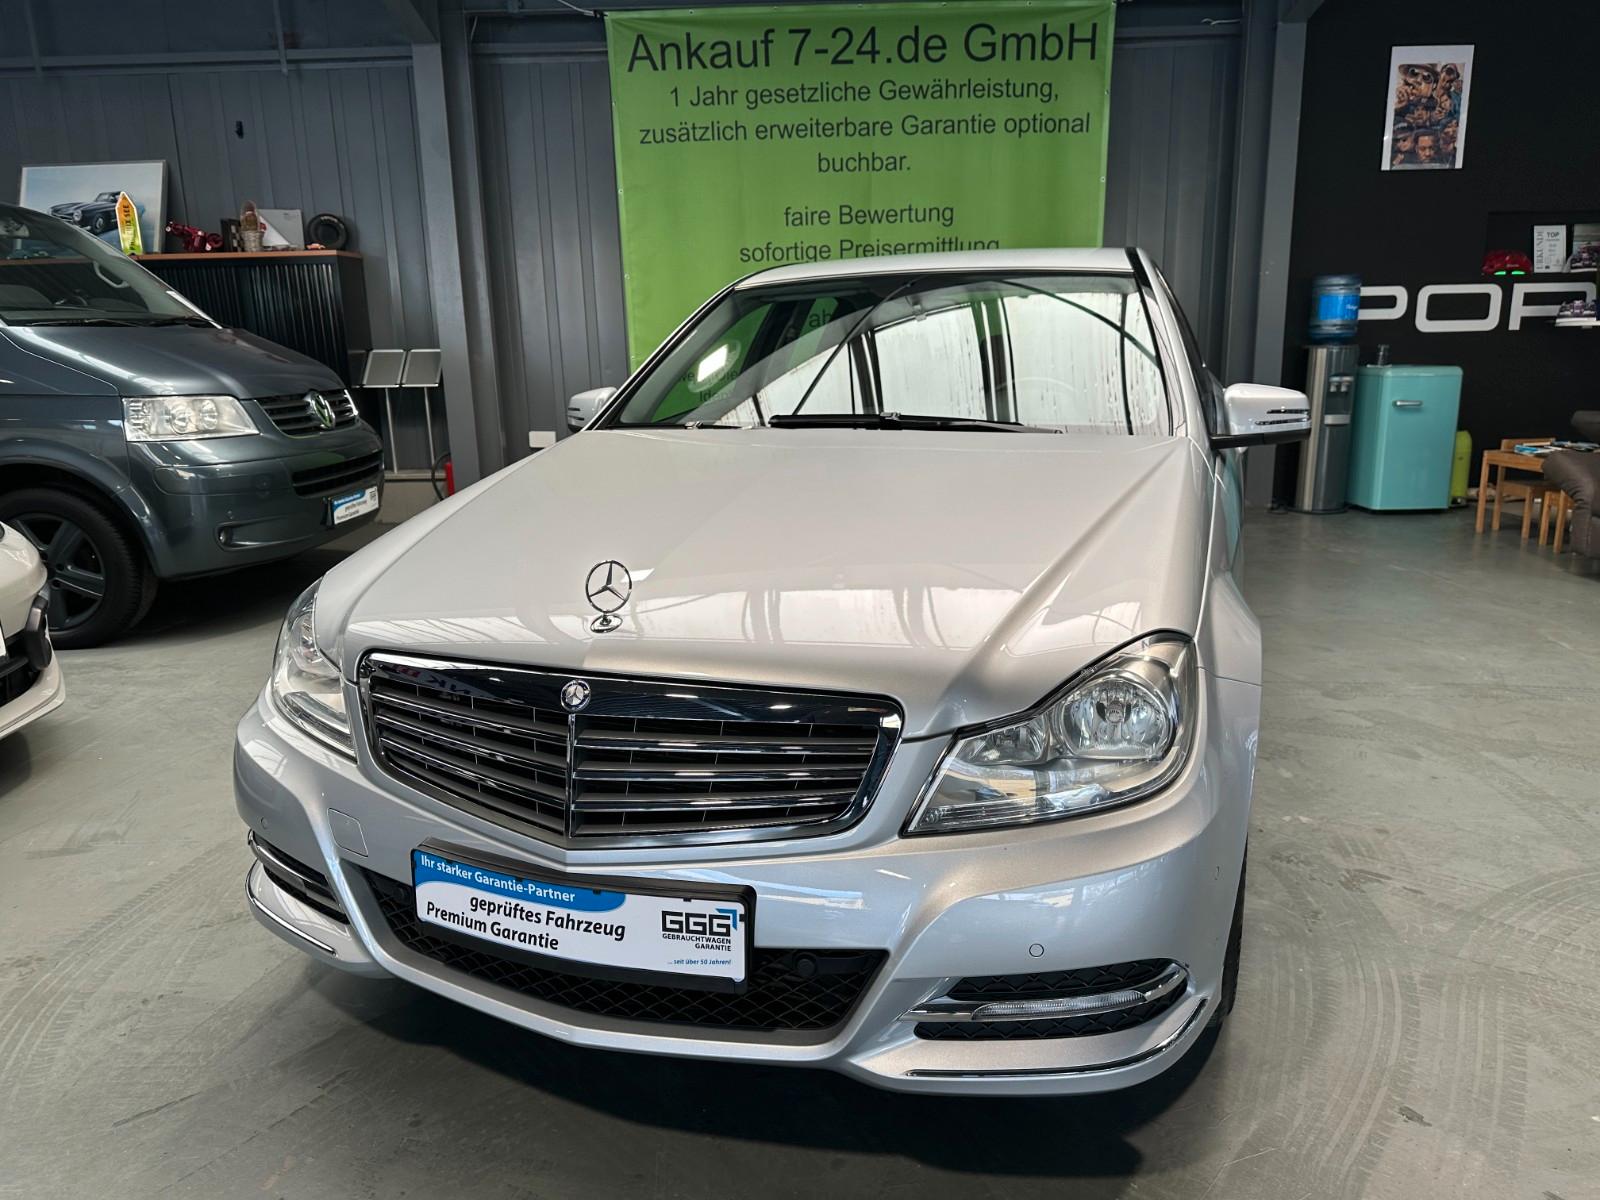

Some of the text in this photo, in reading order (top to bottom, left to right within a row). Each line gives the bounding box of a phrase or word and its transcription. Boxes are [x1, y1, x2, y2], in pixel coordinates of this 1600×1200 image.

[627, 22, 1098, 72] Ankauf 7-24.de GmbH
[670, 78, 1059, 110] 1 Jahr gesetzliche Gewährleistung,
[639, 112, 1090, 144] zusätzlich erweiterbare Garantie optional
[817, 152, 911, 173] buchbar.
[784, 204, 954, 227] faire Bewertung
[739, 241, 832, 263] sofortige
[421, 854, 576, 902] Ihr starker Garantie-Partner
[426, 901, 559, 950] Premium Garantie
[469, 896, 626, 942] geprüftes Fahrzeug
[661, 910, 731, 937] GGG
[662, 933, 732, 945] GEBRAUCHTWAGEN
[694, 943, 732, 952] GARANTIE
